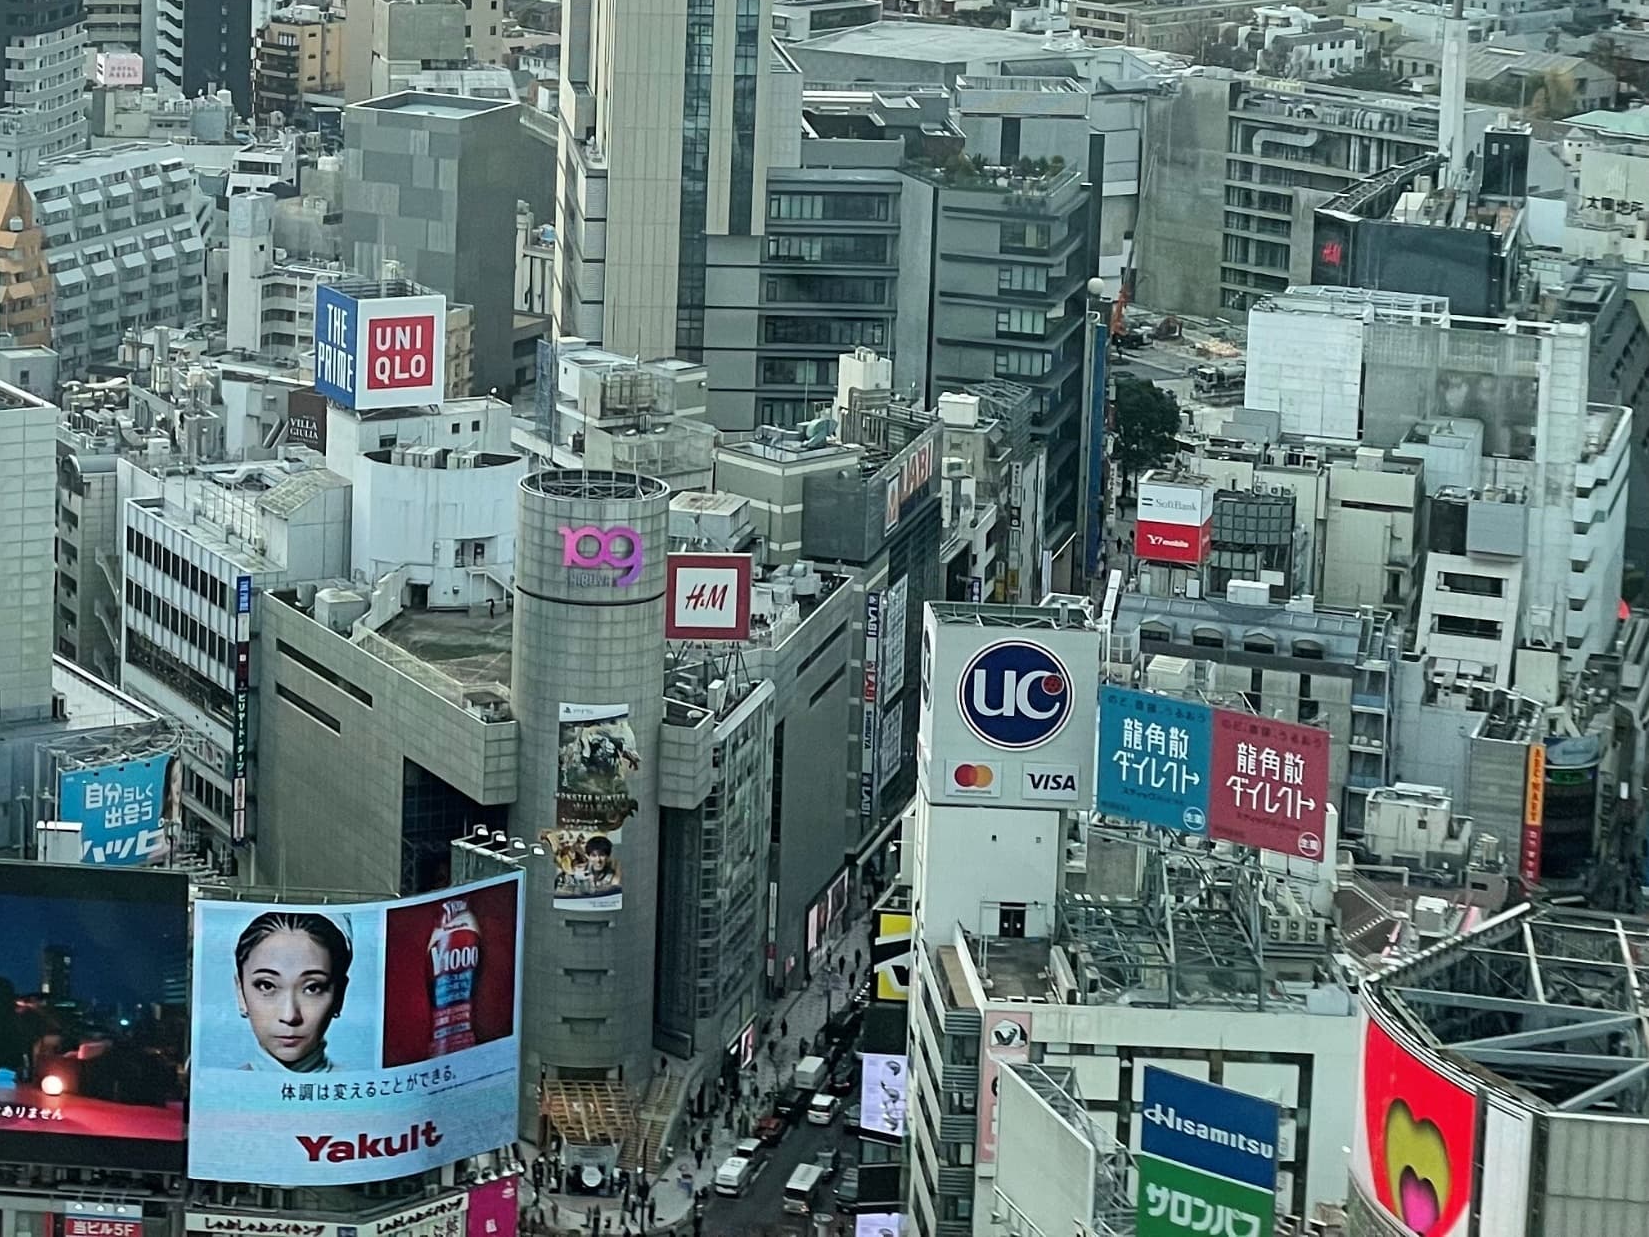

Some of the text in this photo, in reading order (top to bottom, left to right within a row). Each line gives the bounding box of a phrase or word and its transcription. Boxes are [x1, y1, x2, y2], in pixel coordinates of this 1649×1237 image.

[326, 303, 348, 349] THE
[375, 324, 423, 352] UNI
[317, 341, 354, 394] PRIME
[374, 354, 427, 385] QLO
[289, 427, 319, 440] GIULIA
[290, 417, 318, 431] VILLA
[899, 437, 934, 503] LABI
[1155, 498, 1198, 512] SoftBank
[558, 525, 644, 588] 109
[684, 583, 729, 612] H&M
[867, 606, 879, 636] LABI
[973, 668, 1061, 720] UC
[1122, 717, 1190, 761] 龍角散
[1026, 772, 1077, 792] VISA
[1112, 750, 1201, 795] ダイレクト
[1237, 741, 1305, 786] 龍角散
[85, 782, 154, 810] 自分らしく
[861, 785, 872, 816] LABI
[1225, 775, 1317, 820] ダイレクト
[281, 1065, 457, 1102] 体調は変えることができる。
[294, 1120, 445, 1163] Yakult
[1143, 1102, 1274, 1159] Hisamitsu
[72, 1220, 135, 1236] 当ビル5F
